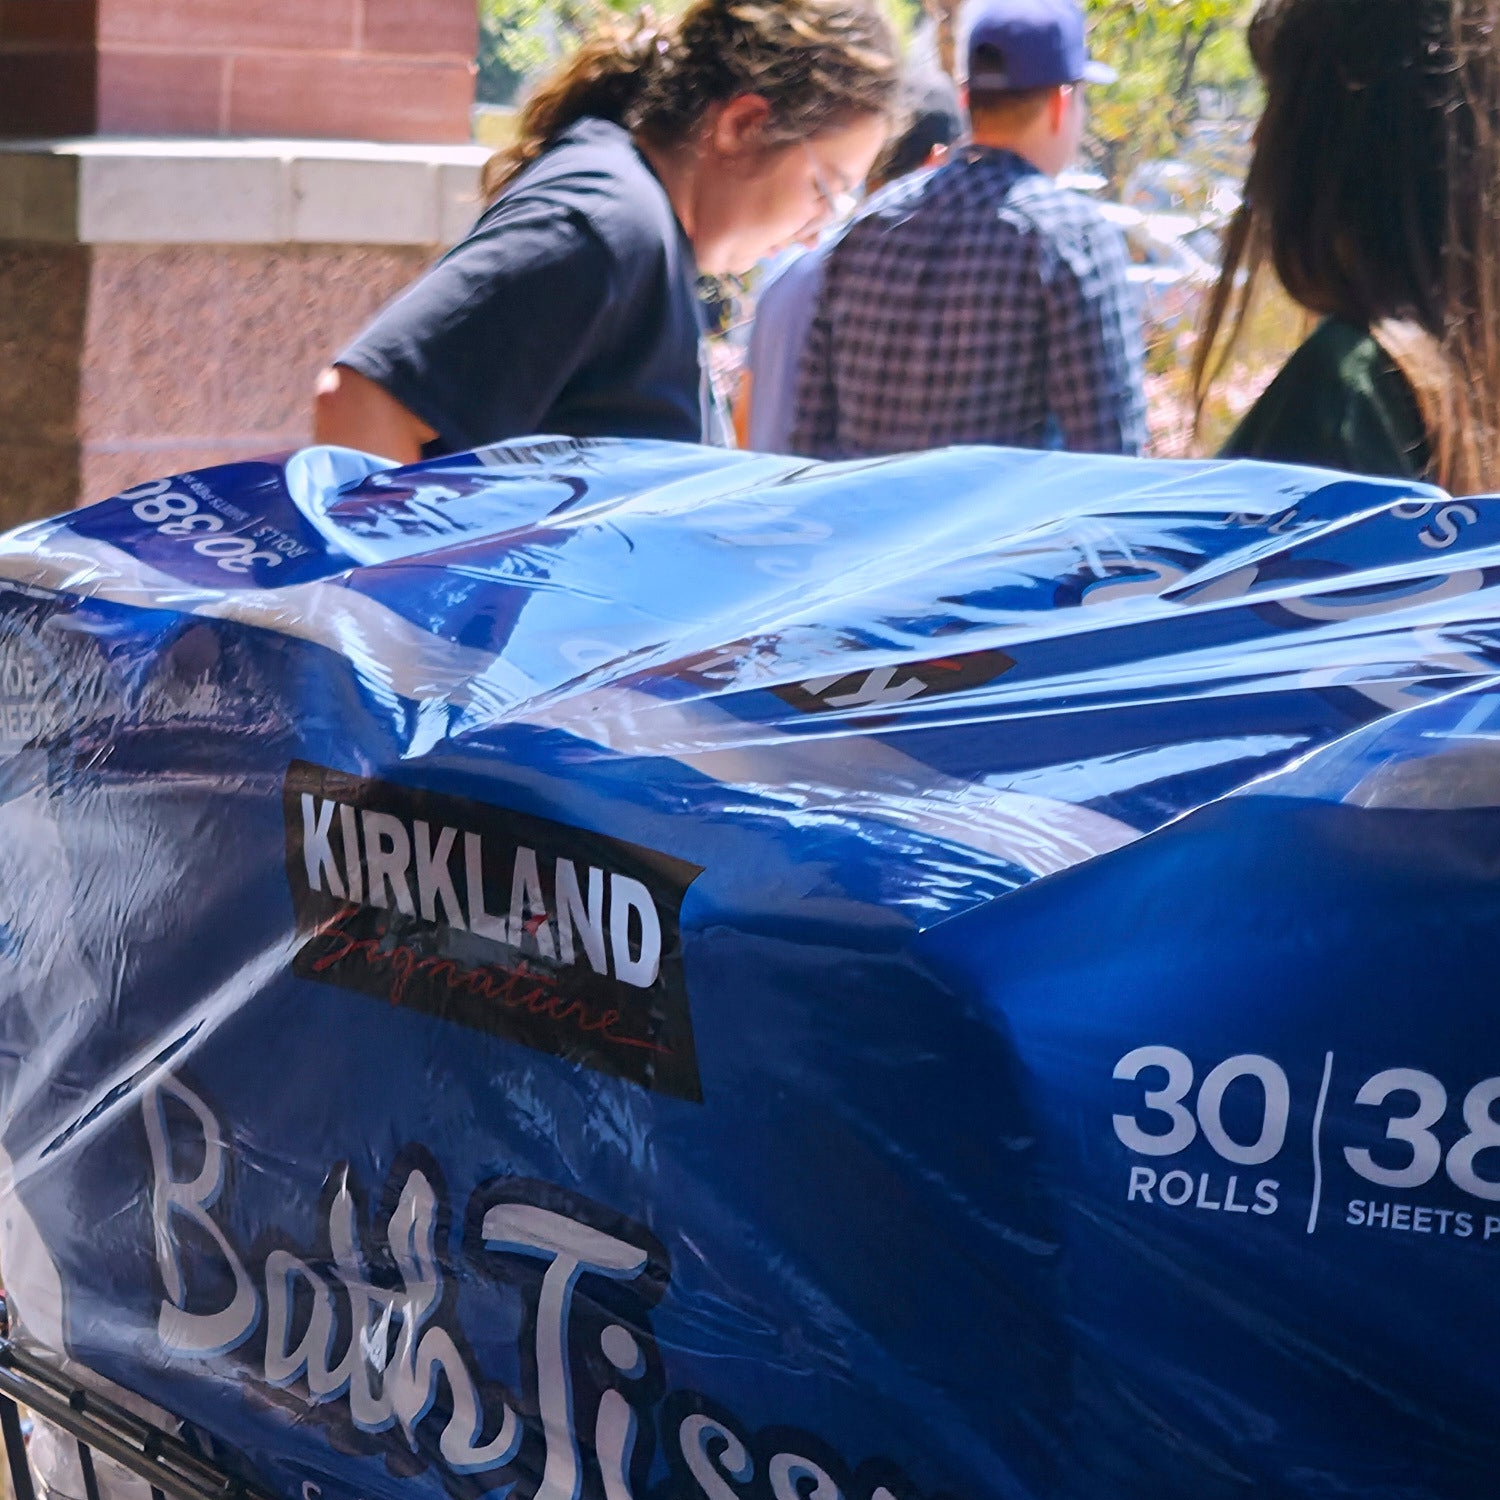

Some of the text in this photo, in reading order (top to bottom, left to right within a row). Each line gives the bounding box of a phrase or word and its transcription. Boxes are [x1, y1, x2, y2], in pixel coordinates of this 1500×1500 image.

[300, 793, 661, 989] KIRKLAND
[312, 904, 678, 1054] Signature
[1110, 1043, 1292, 1169] 30
[1124, 1163, 1281, 1217] ROLLS
[1345, 1198, 1476, 1241] SHEETS
[142, 1065, 523, 1472] Bath
